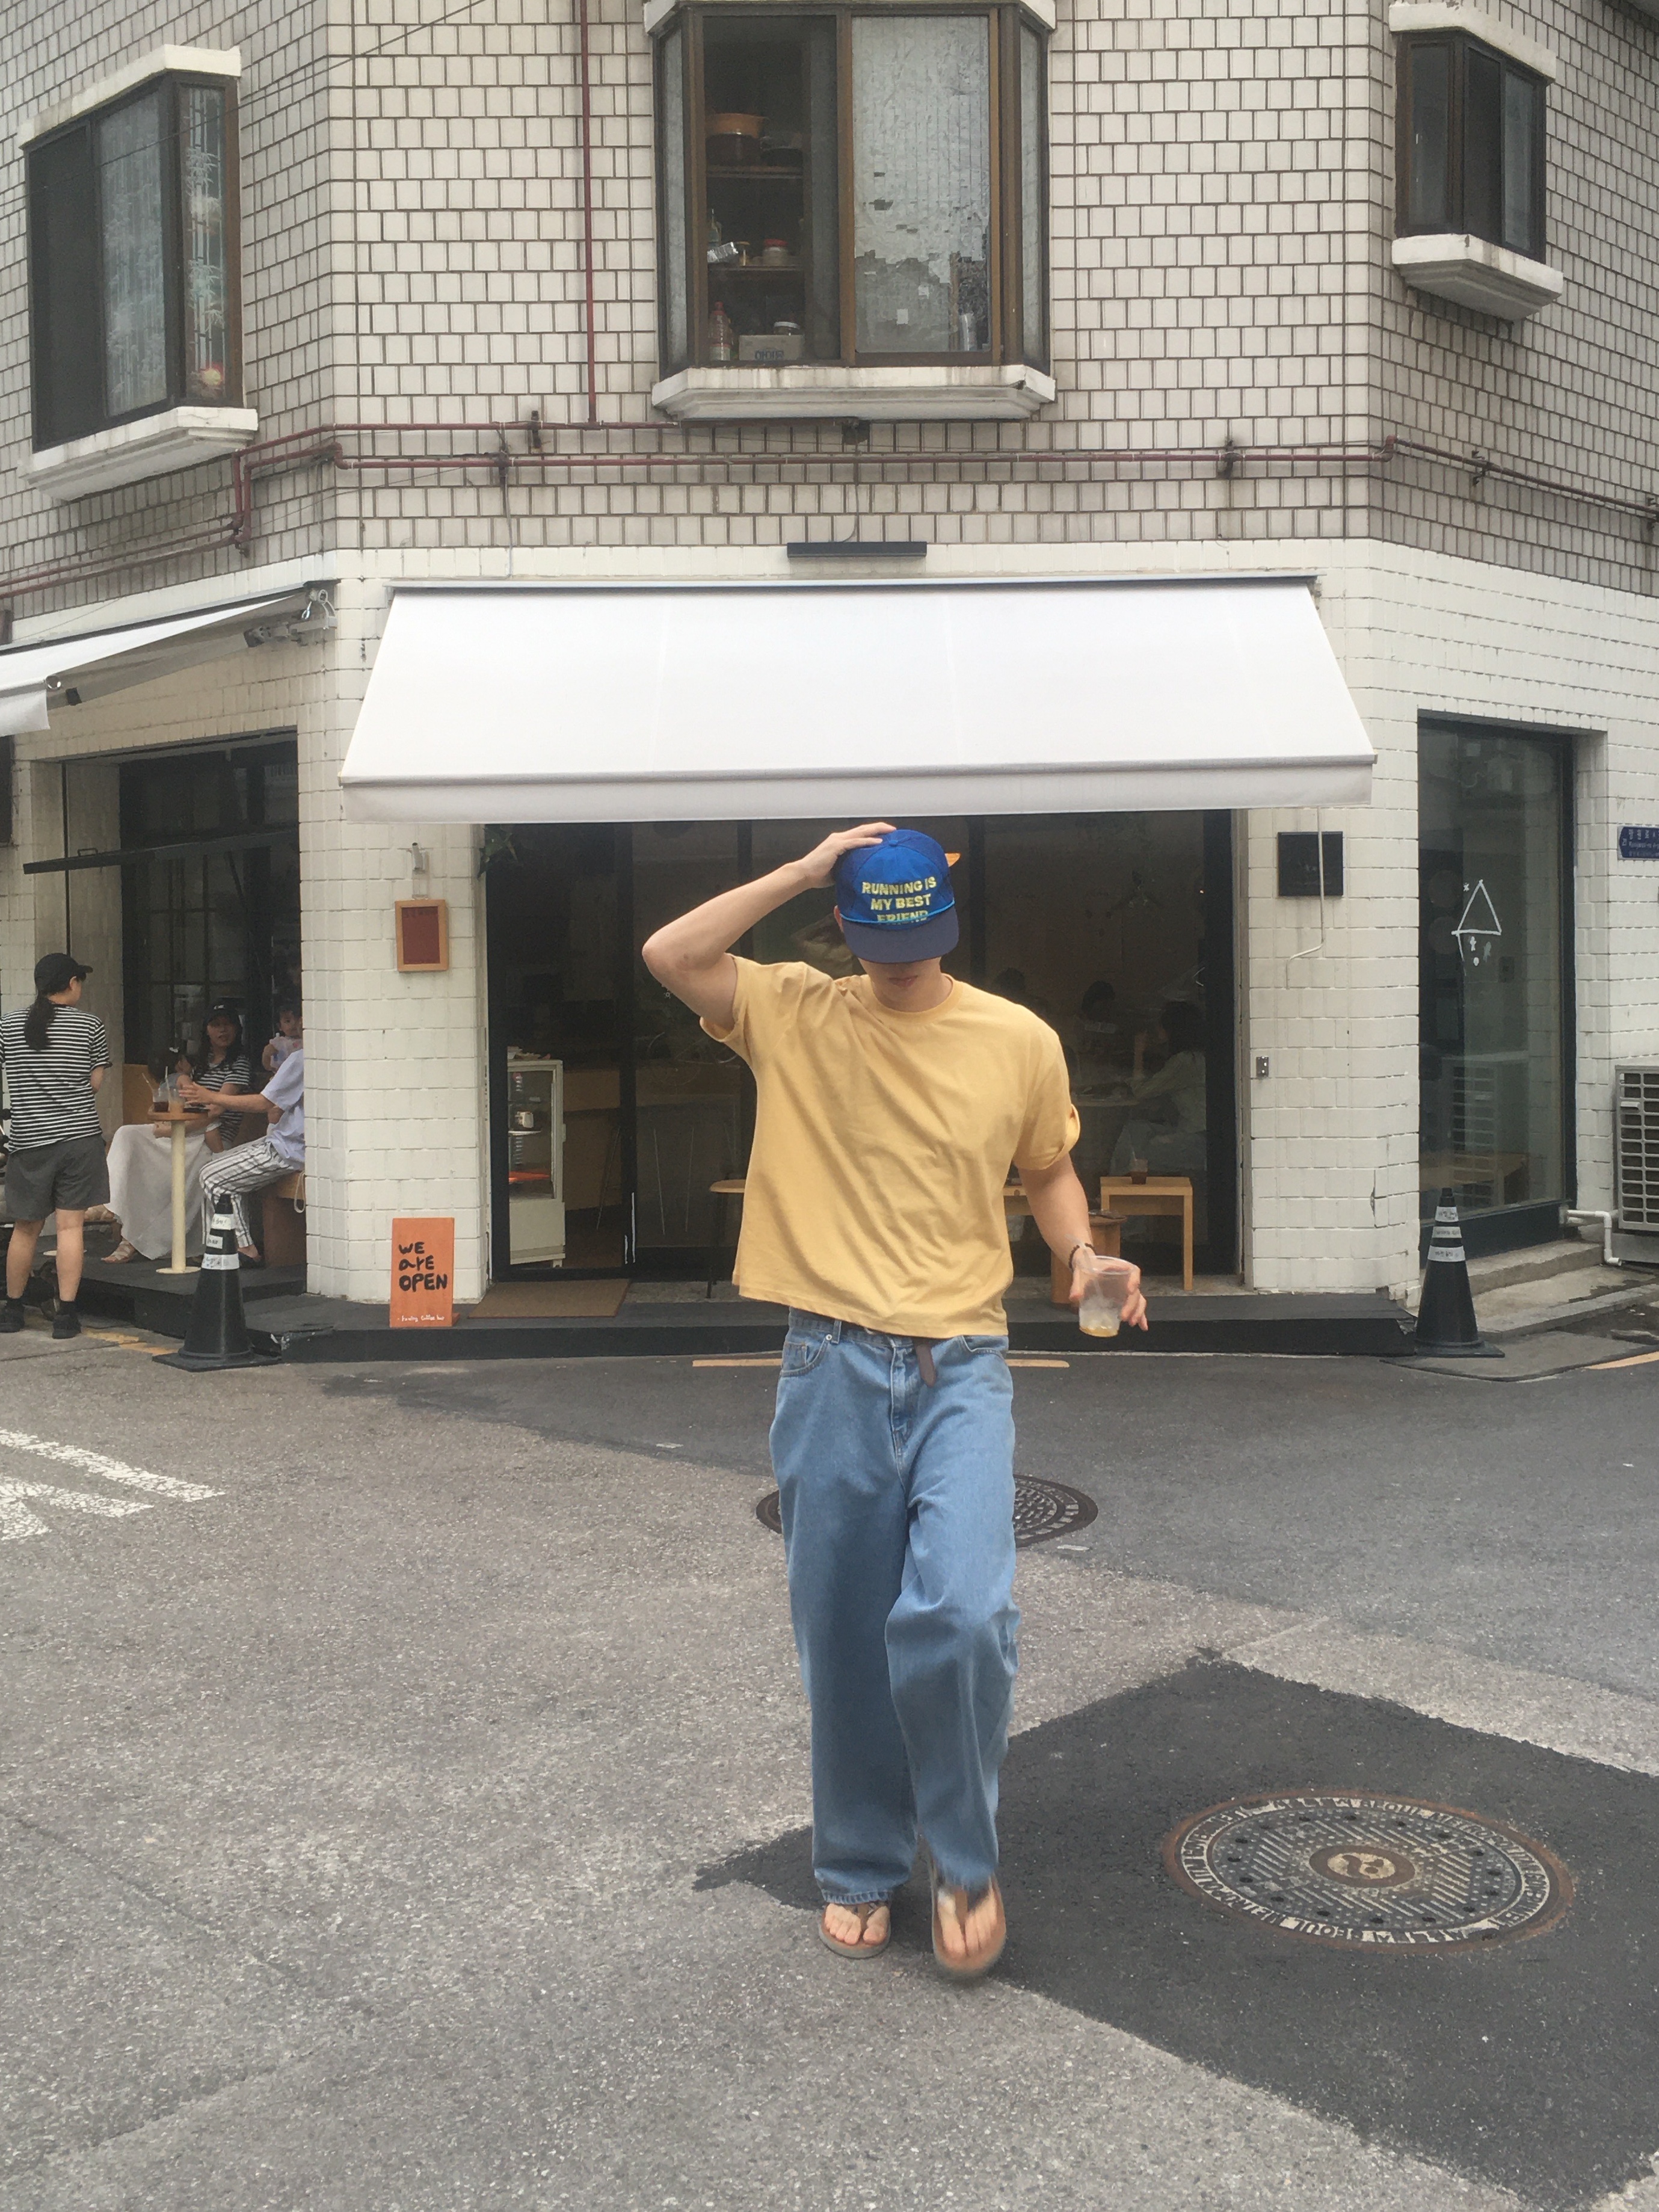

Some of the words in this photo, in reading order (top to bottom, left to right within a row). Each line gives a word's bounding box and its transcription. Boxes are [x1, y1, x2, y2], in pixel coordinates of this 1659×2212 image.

[862, 880, 922, 895] RUNNING
[925, 876, 937, 890] IS
[870, 898, 892, 910] MY
[895, 893, 931, 909] BEST
[877, 910, 929, 924] FRIEND
[398, 1242, 425, 1254] WE
[399, 1273, 448, 1292] OPEN
